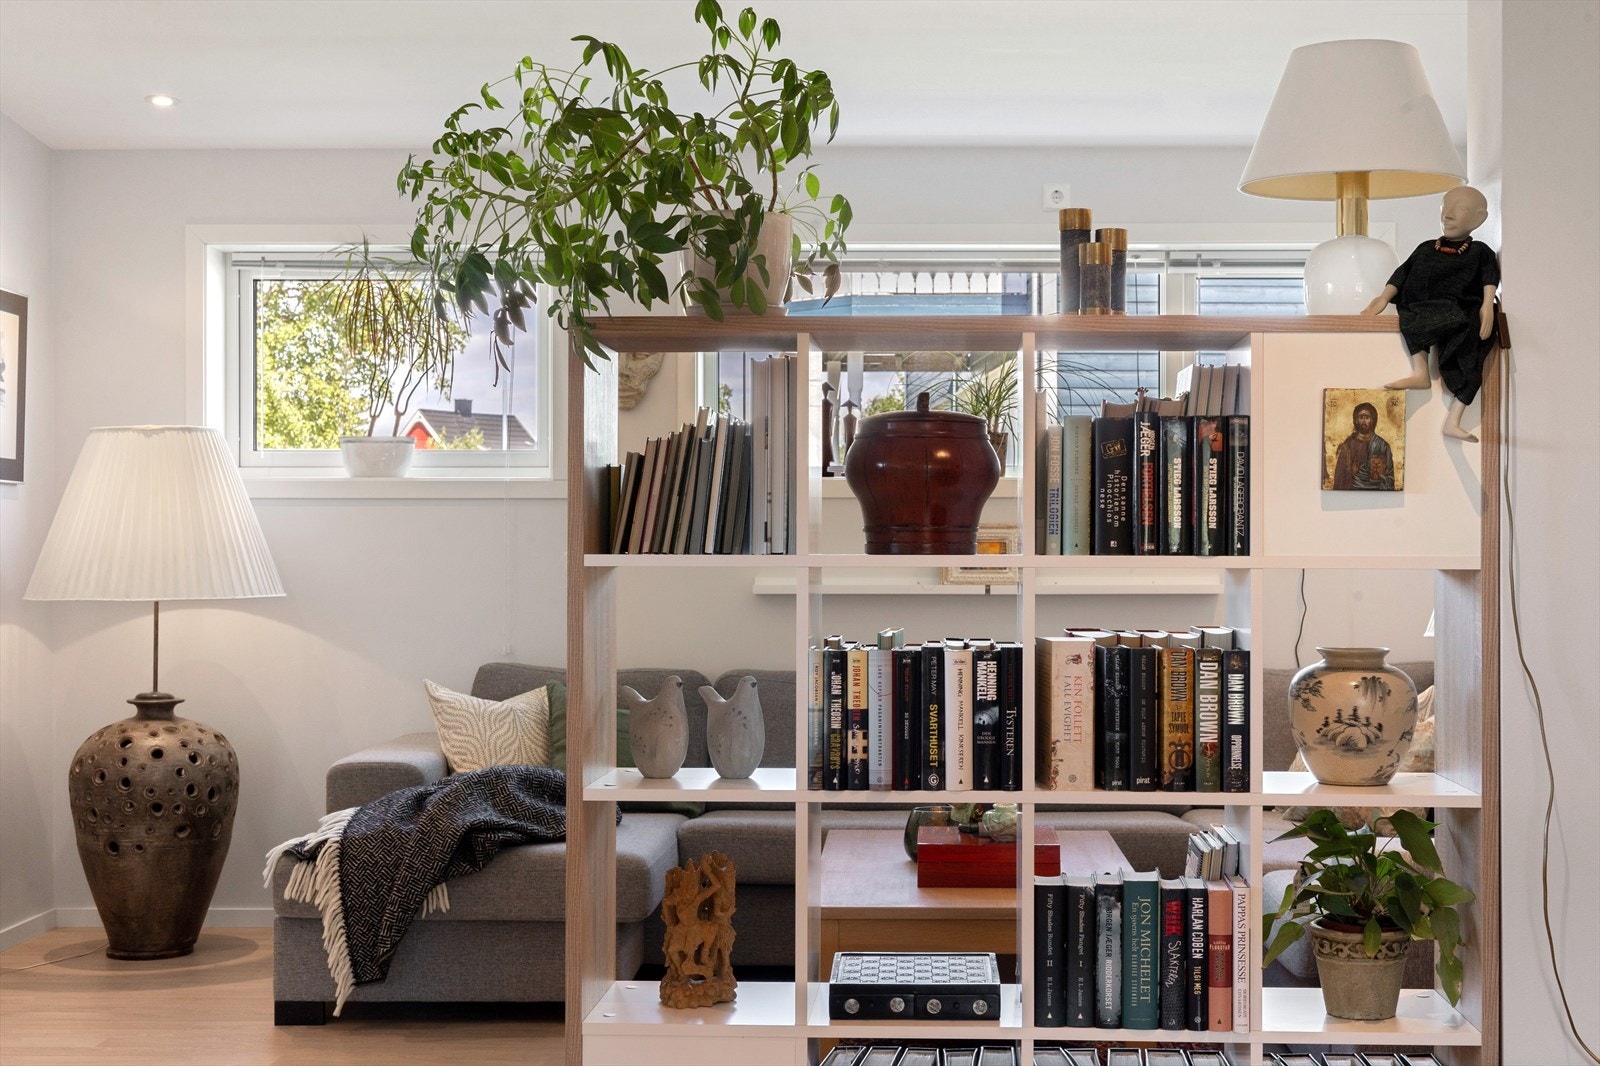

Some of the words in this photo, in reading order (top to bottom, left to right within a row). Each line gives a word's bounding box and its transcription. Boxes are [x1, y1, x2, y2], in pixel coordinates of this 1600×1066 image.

[1050, 434, 1059, 451] JON
[1140, 421, 1150, 456] JÆGER
[1050, 455, 1059, 483] FOSSE
[1208, 458, 1217, 484] STIEG
[1142, 462, 1154, 525] FORTIELSEN
[1208, 487, 1217, 529] LARSSON
[1049, 488, 1059, 535] TRILOGIEN
[1114, 515, 1119, 527] om
[1171, 652, 1187, 668] DAN
[1200, 662, 1218, 689] DAN
[830, 671, 842, 695] JOHAN
[977, 661, 987, 700] MANKELL
[987, 661, 997, 700] HENNING
[1074, 676, 1082, 696] KEN
[1171, 671, 1187, 702] BROWN
[1228, 674, 1245, 691] DAN
[830, 699, 842, 729] THEORIN
[852, 691, 860, 720] THEORIN
[1200, 695, 1218, 743] BROWN
[1228, 694, 1245, 725] BROWN
[929, 704, 938, 767] SVARTHUSET
[1074, 700, 1082, 744] FOLLETT
[1230, 734, 1242, 770] OPPRINNELSE
[1132, 902, 1139, 912] En
[1138, 896, 1152, 927] JON
[1191, 898, 1204, 930] HARLAN
[1237, 894, 1246, 929] PAPPAS
[1129, 915, 1139, 936] sjøens
[1192, 932, 1204, 959] COBEN
[1237, 931, 1246, 983] PRINSESSE
[1140, 930, 1151, 1003] MICHELET
[1165, 940, 1182, 988] SLAKTEREN
